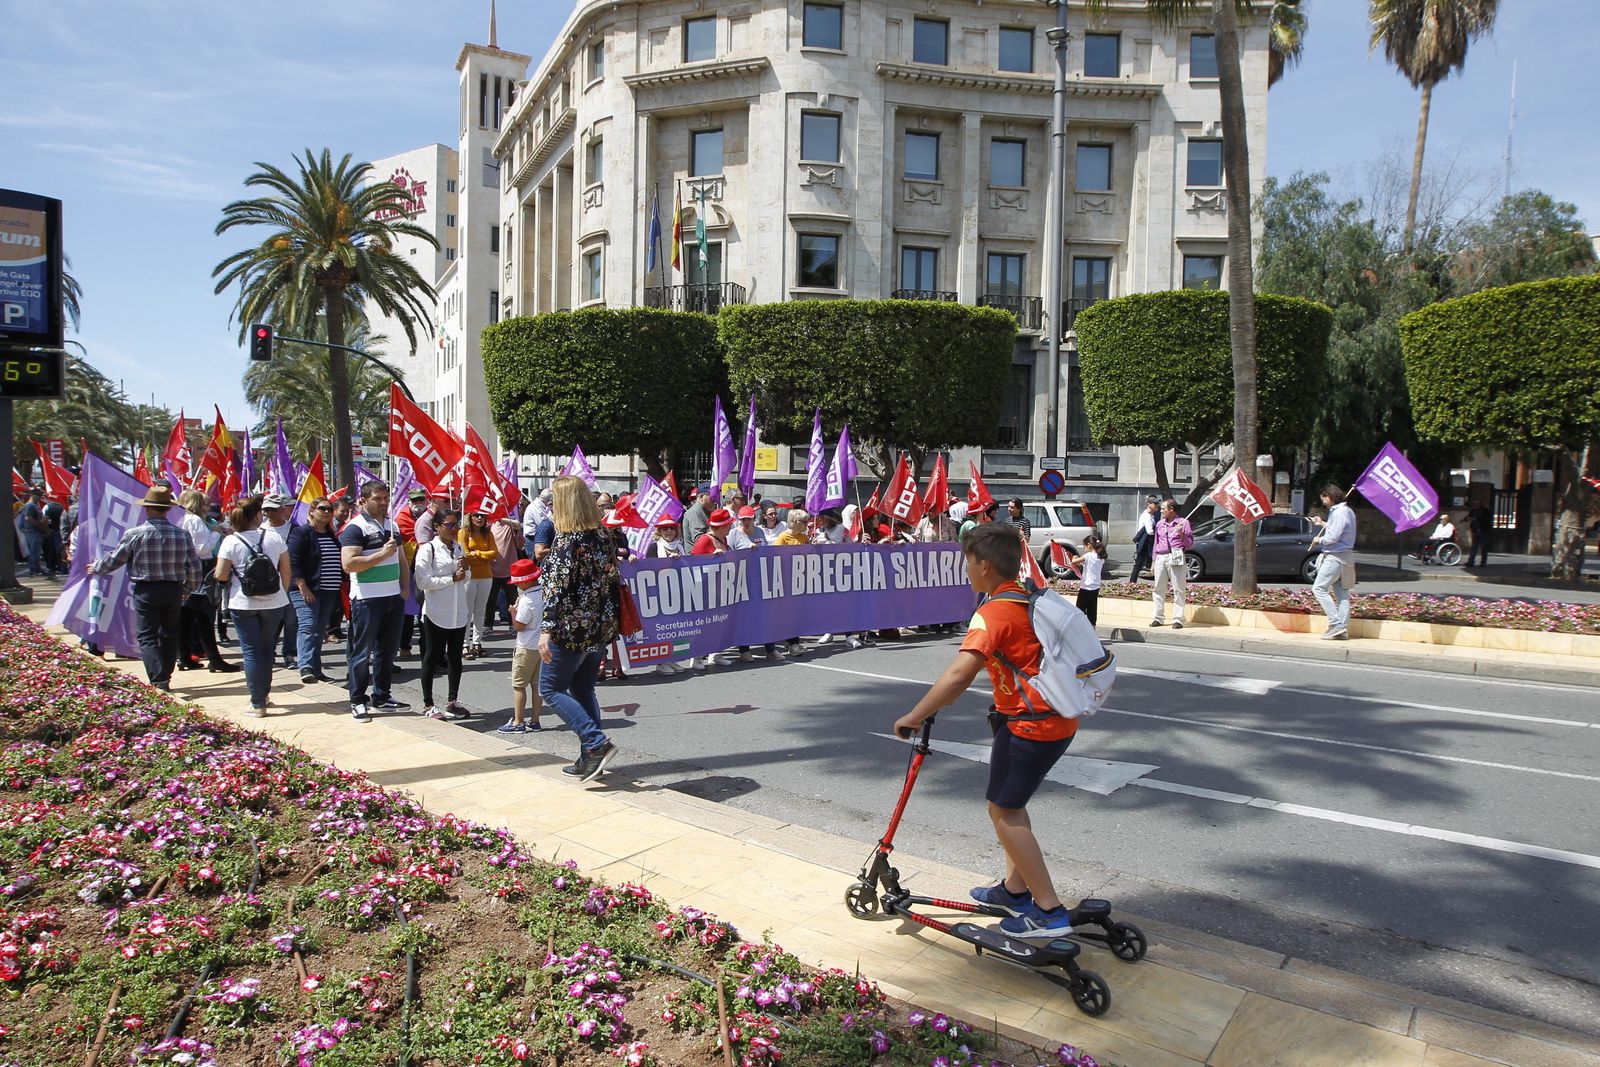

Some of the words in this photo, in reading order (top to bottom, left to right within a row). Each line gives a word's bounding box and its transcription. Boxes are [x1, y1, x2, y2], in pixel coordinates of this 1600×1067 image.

[0, 231, 41, 247] um
[10, 271, 31, 280] Gata
[4, 303, 24, 324] P
[760, 555, 785, 600] LA
[791, 551, 887, 596] BRECHA
[695, 617, 704, 627] de
[705, 615, 712, 625] la
[713, 613, 729, 624] Mujer
[656, 631, 677, 641] CCOO
[629, 645, 669, 660] CCOO
